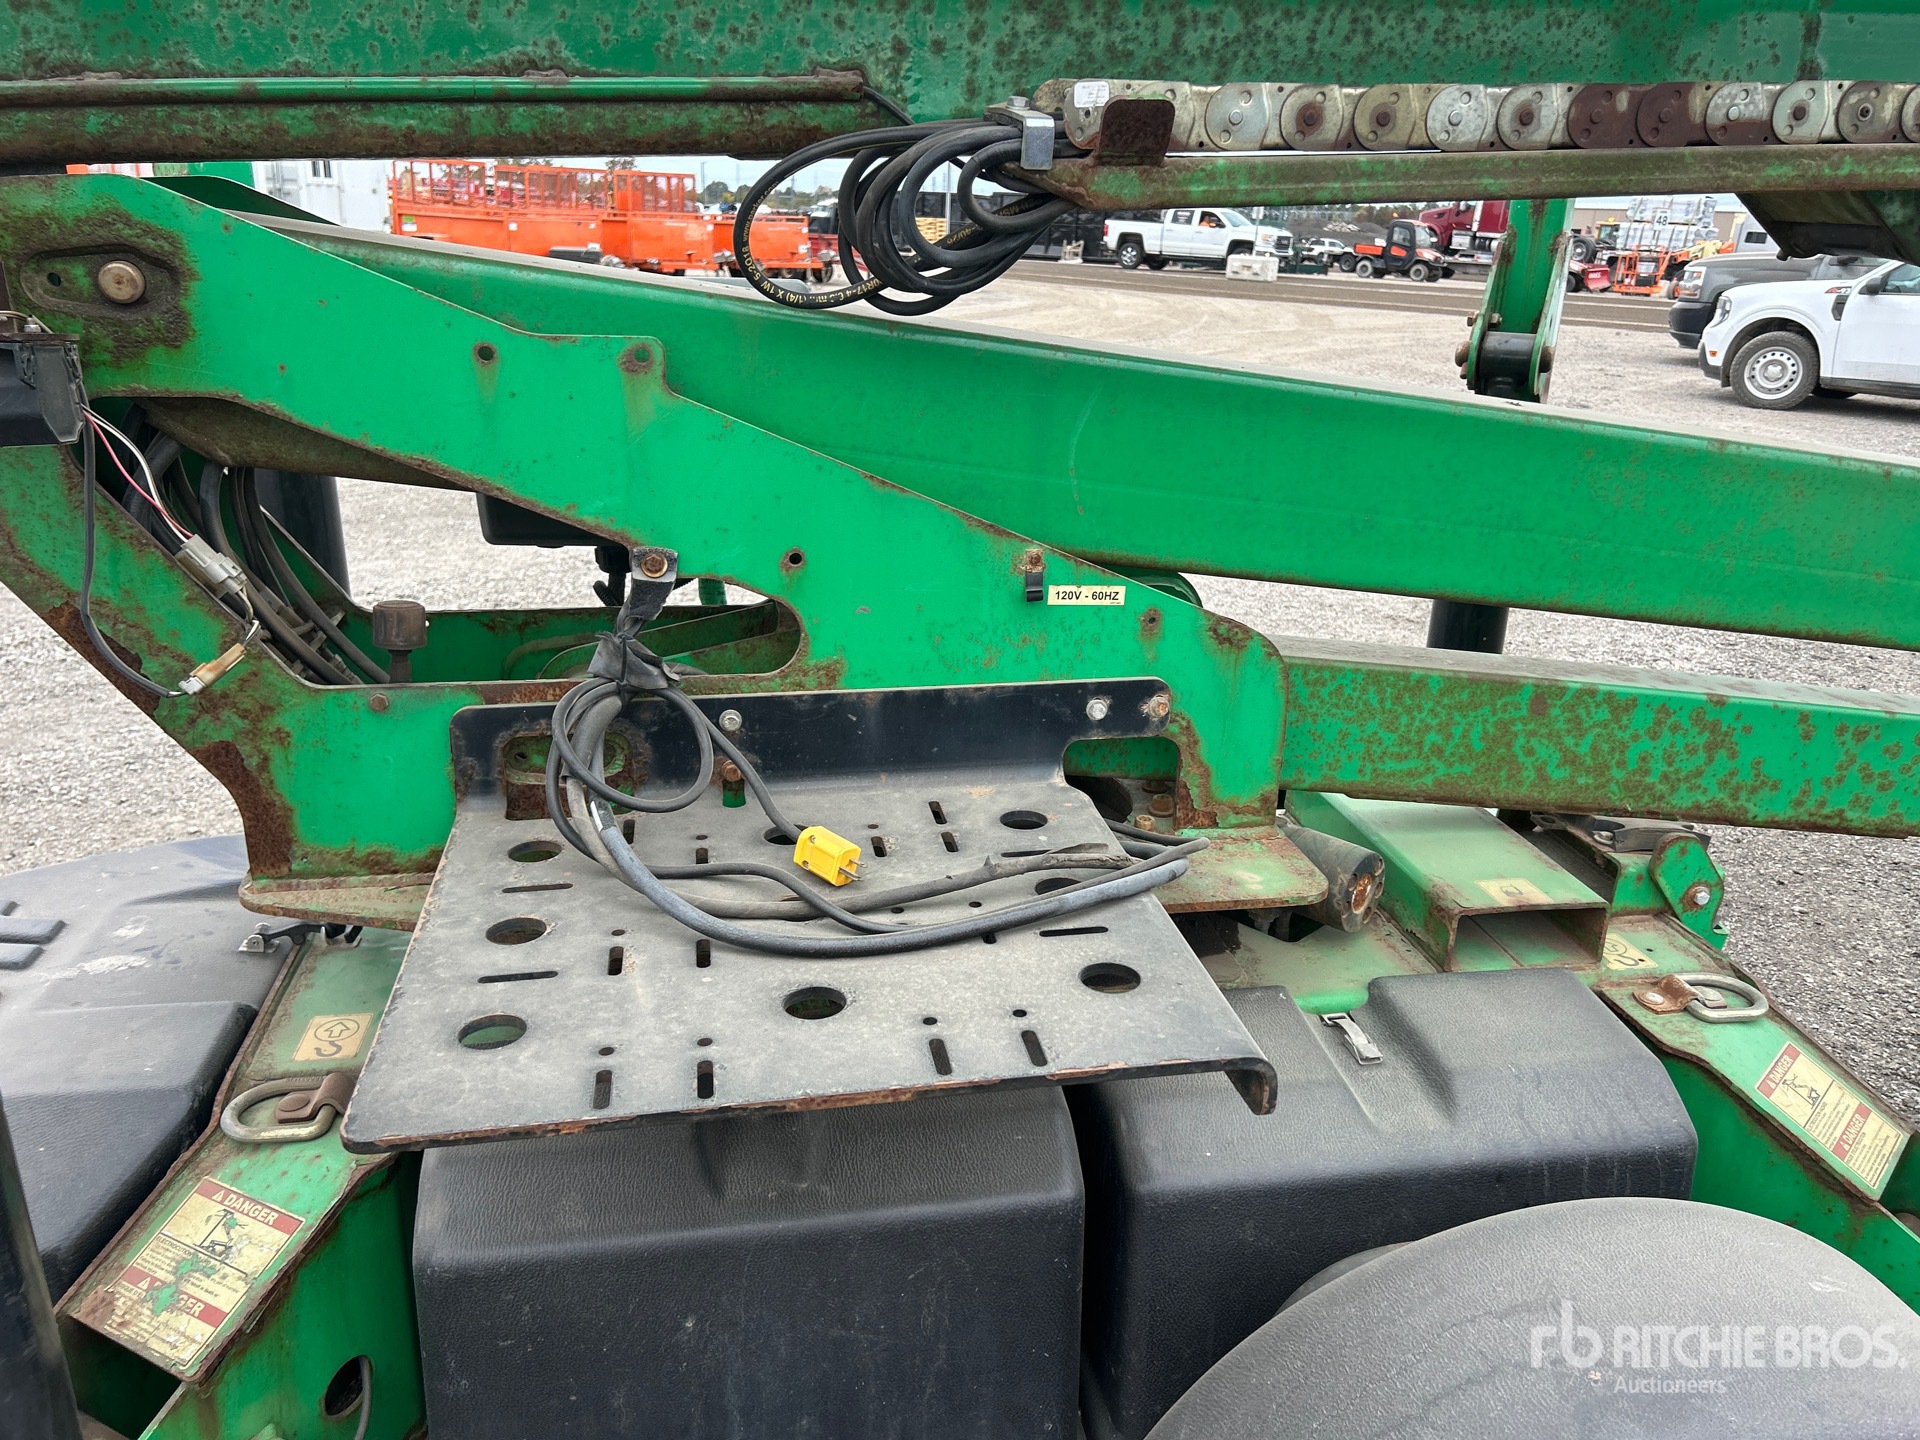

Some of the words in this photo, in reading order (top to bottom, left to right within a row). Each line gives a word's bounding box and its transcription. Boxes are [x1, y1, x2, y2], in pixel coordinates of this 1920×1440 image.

[1655, 214, 1669, 226] 48
[741, 245, 761, 281] 5-2018
[760, 280, 775, 293] 1W
[776, 288, 785, 299] X
[845, 278, 883, 298] 0R17-4
[1055, 590, 1082, 601] 120V
[1091, 591, 1120, 601] 60HZ
[1769, 1054, 1795, 1081] DANGER
[1842, 1113, 1865, 1145] DANGER
[223, 1192, 279, 1226] DANGER
